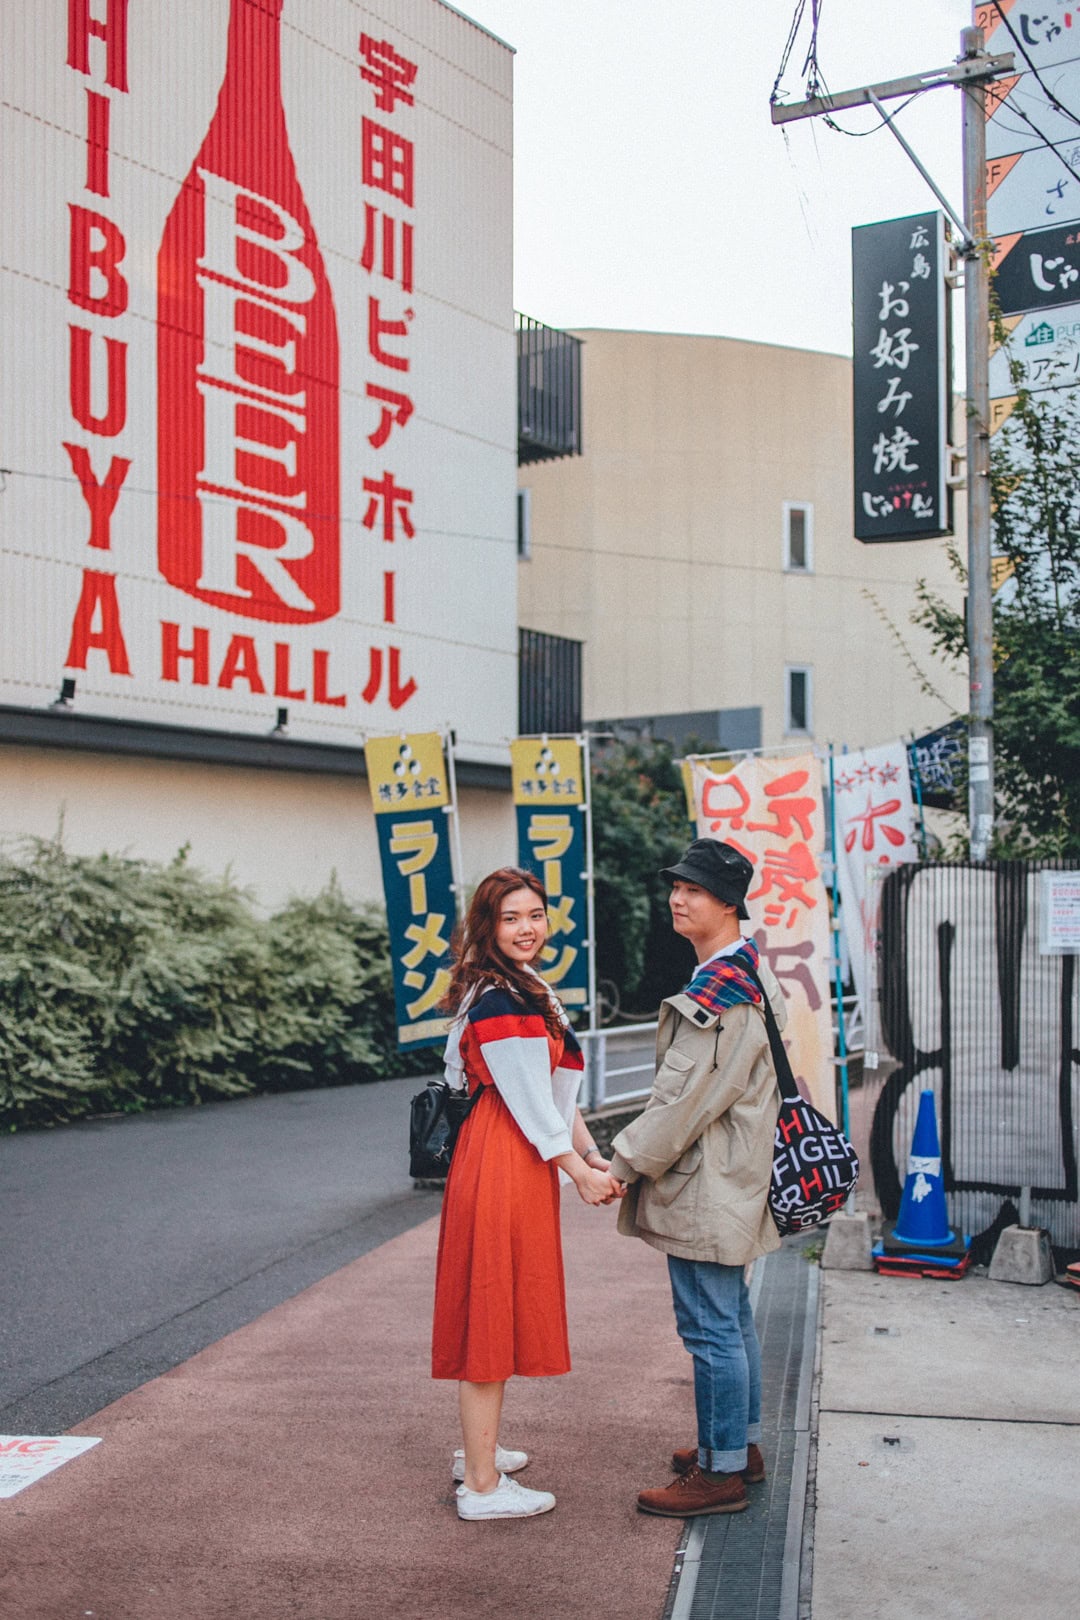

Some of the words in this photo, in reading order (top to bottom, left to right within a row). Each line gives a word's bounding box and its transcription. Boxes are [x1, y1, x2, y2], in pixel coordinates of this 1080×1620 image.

[909, 226, 931, 279] 広島
[196, 165, 316, 612] BEER
[359, 31, 419, 711] 宇田川ビアホール
[869, 280, 920, 475] お好み焼
[160, 620, 347, 708] HALL
[389, 820, 450, 1020] ラーメン
[528, 814, 578, 985] ラーメン
